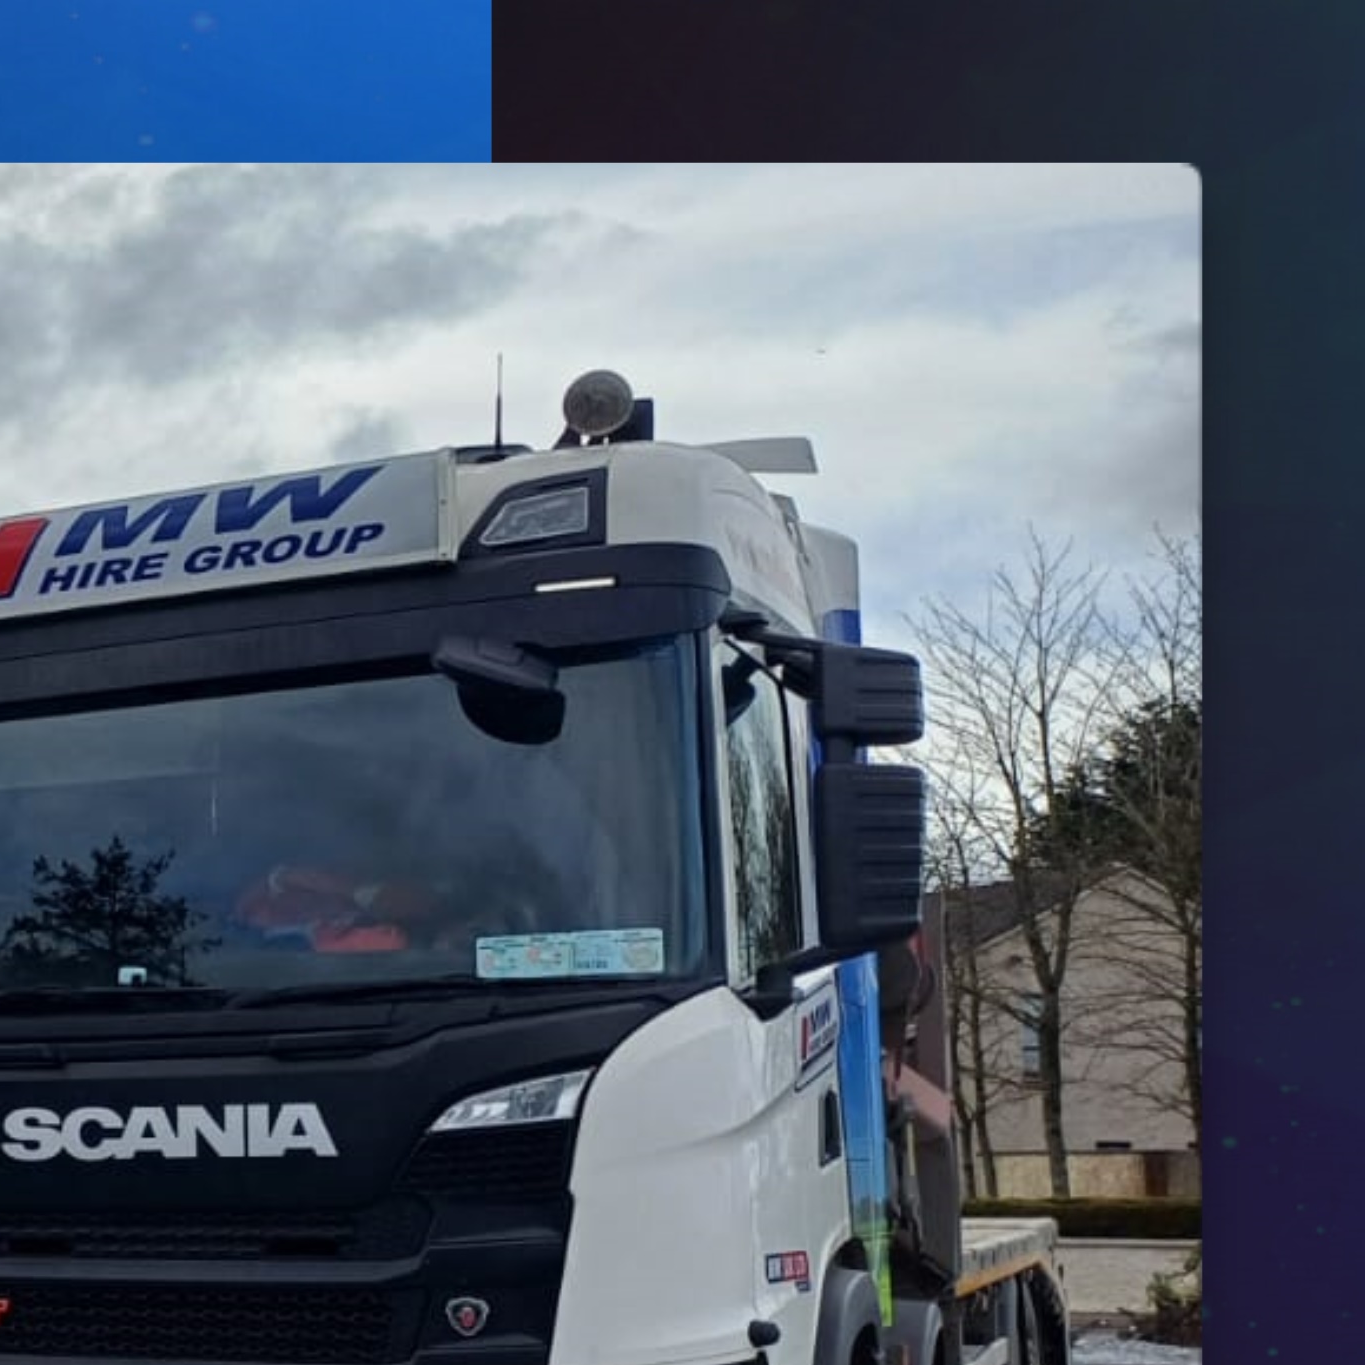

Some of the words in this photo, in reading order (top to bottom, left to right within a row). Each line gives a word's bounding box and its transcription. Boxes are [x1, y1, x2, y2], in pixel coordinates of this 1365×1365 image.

[53, 464, 389, 556] MW
[38, 552, 168, 595] HIRE
[183, 523, 386, 574] GROUP
[1, 1102, 339, 1162] SCANIA
